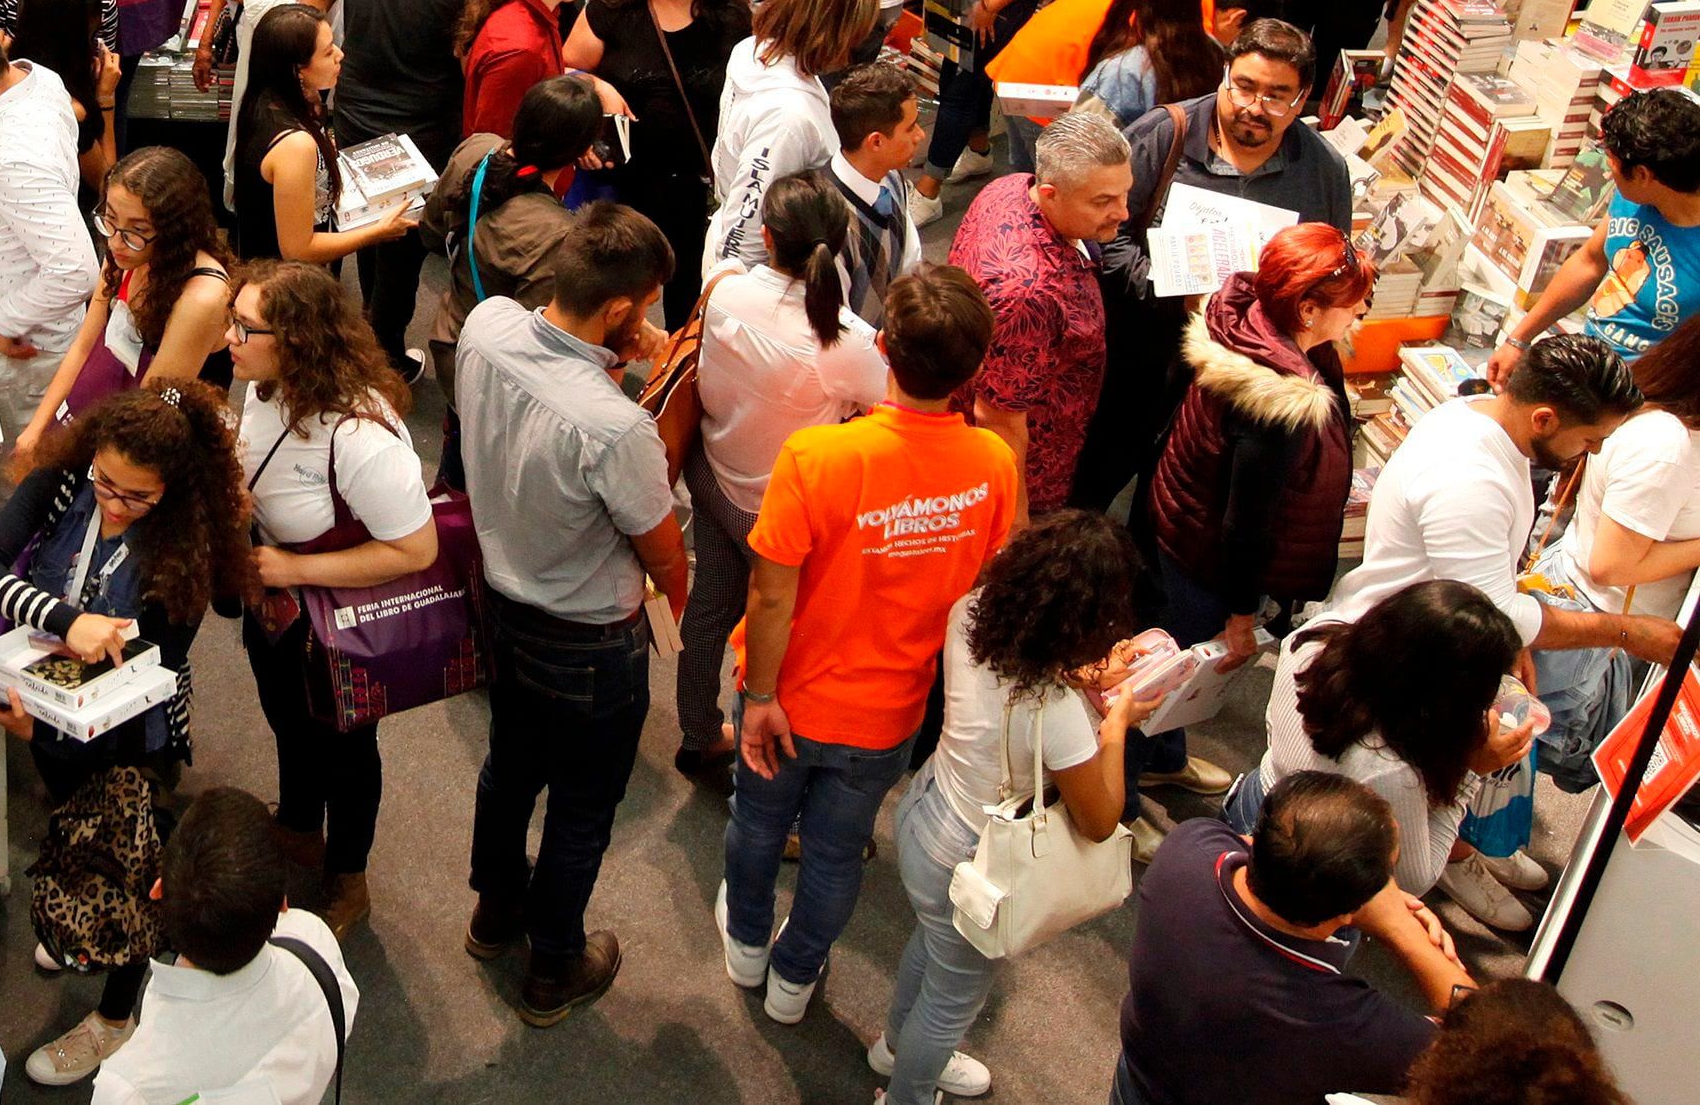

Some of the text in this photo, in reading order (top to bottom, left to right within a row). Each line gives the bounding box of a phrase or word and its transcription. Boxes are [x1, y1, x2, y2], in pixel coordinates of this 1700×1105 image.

[746, 147, 770, 194] ISLA
[1608, 217, 1640, 238] BIG
[1604, 322, 1651, 353] GANG
[884, 512, 961, 540] LIBROS
[357, 585, 443, 615] FERIA INTERNACIONAL
[360, 587, 466, 623] DEL LIBRO DE GUADALAJAR
